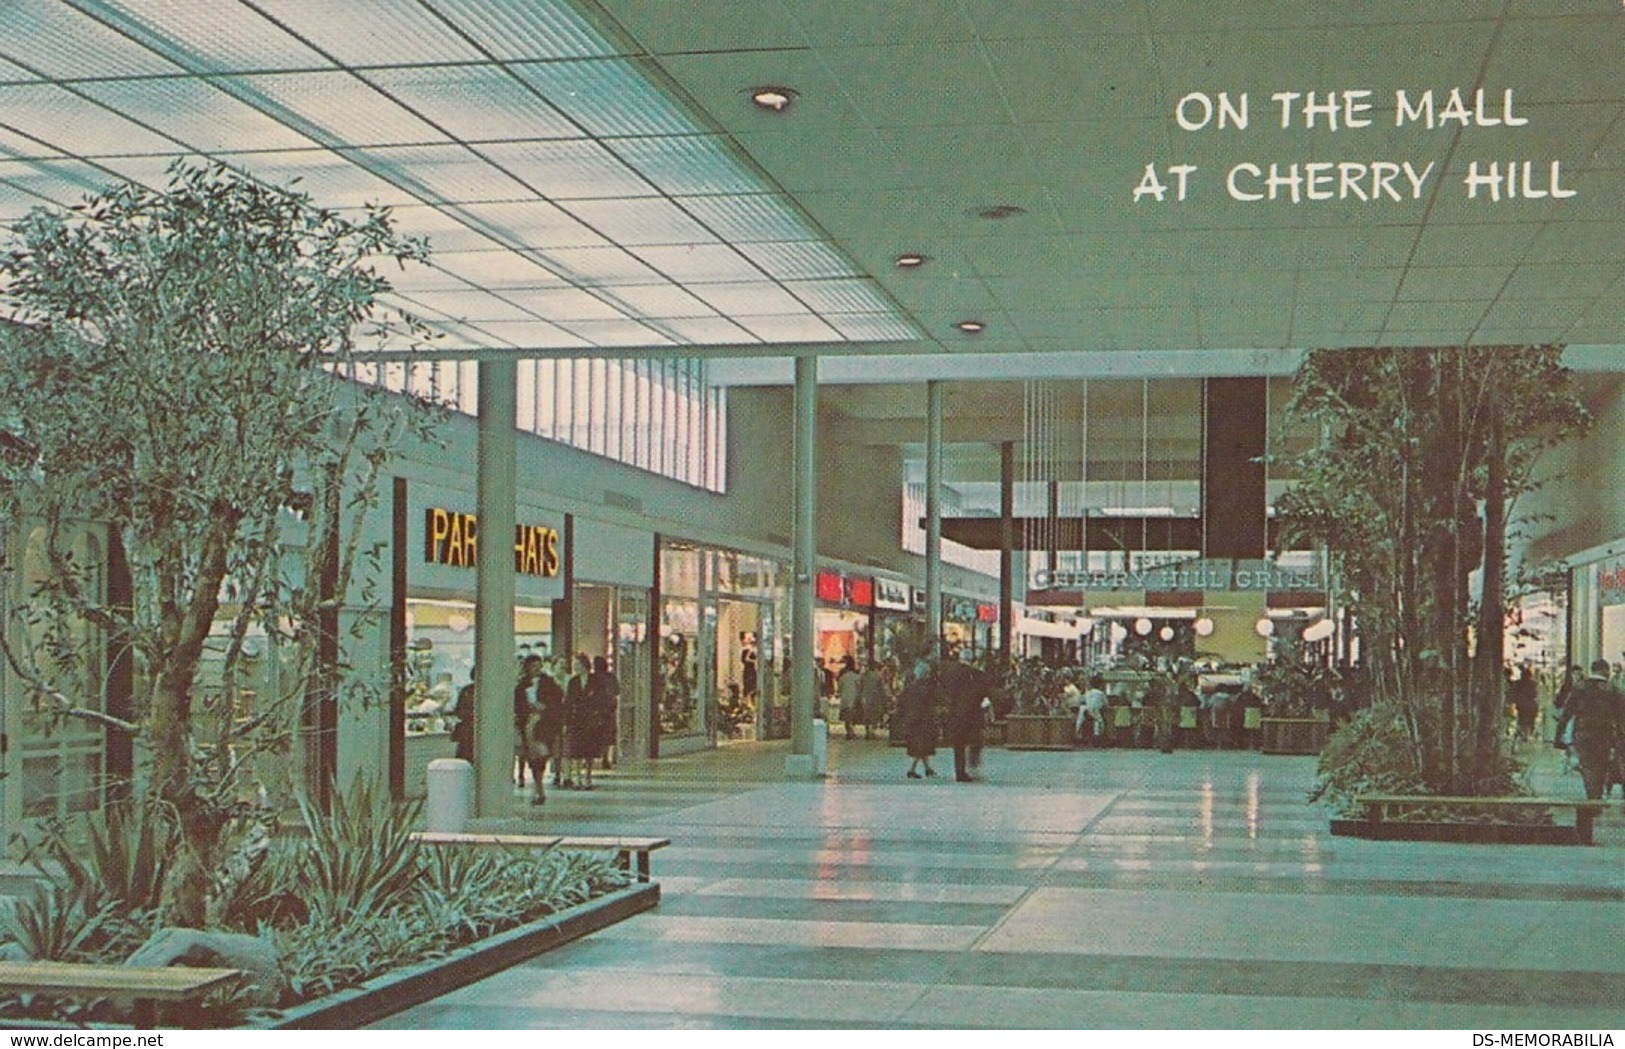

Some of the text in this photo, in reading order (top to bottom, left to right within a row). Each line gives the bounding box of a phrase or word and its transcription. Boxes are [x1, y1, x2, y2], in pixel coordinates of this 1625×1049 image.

[1034, 569, 1319, 588] CHERRY HILL GRILL
